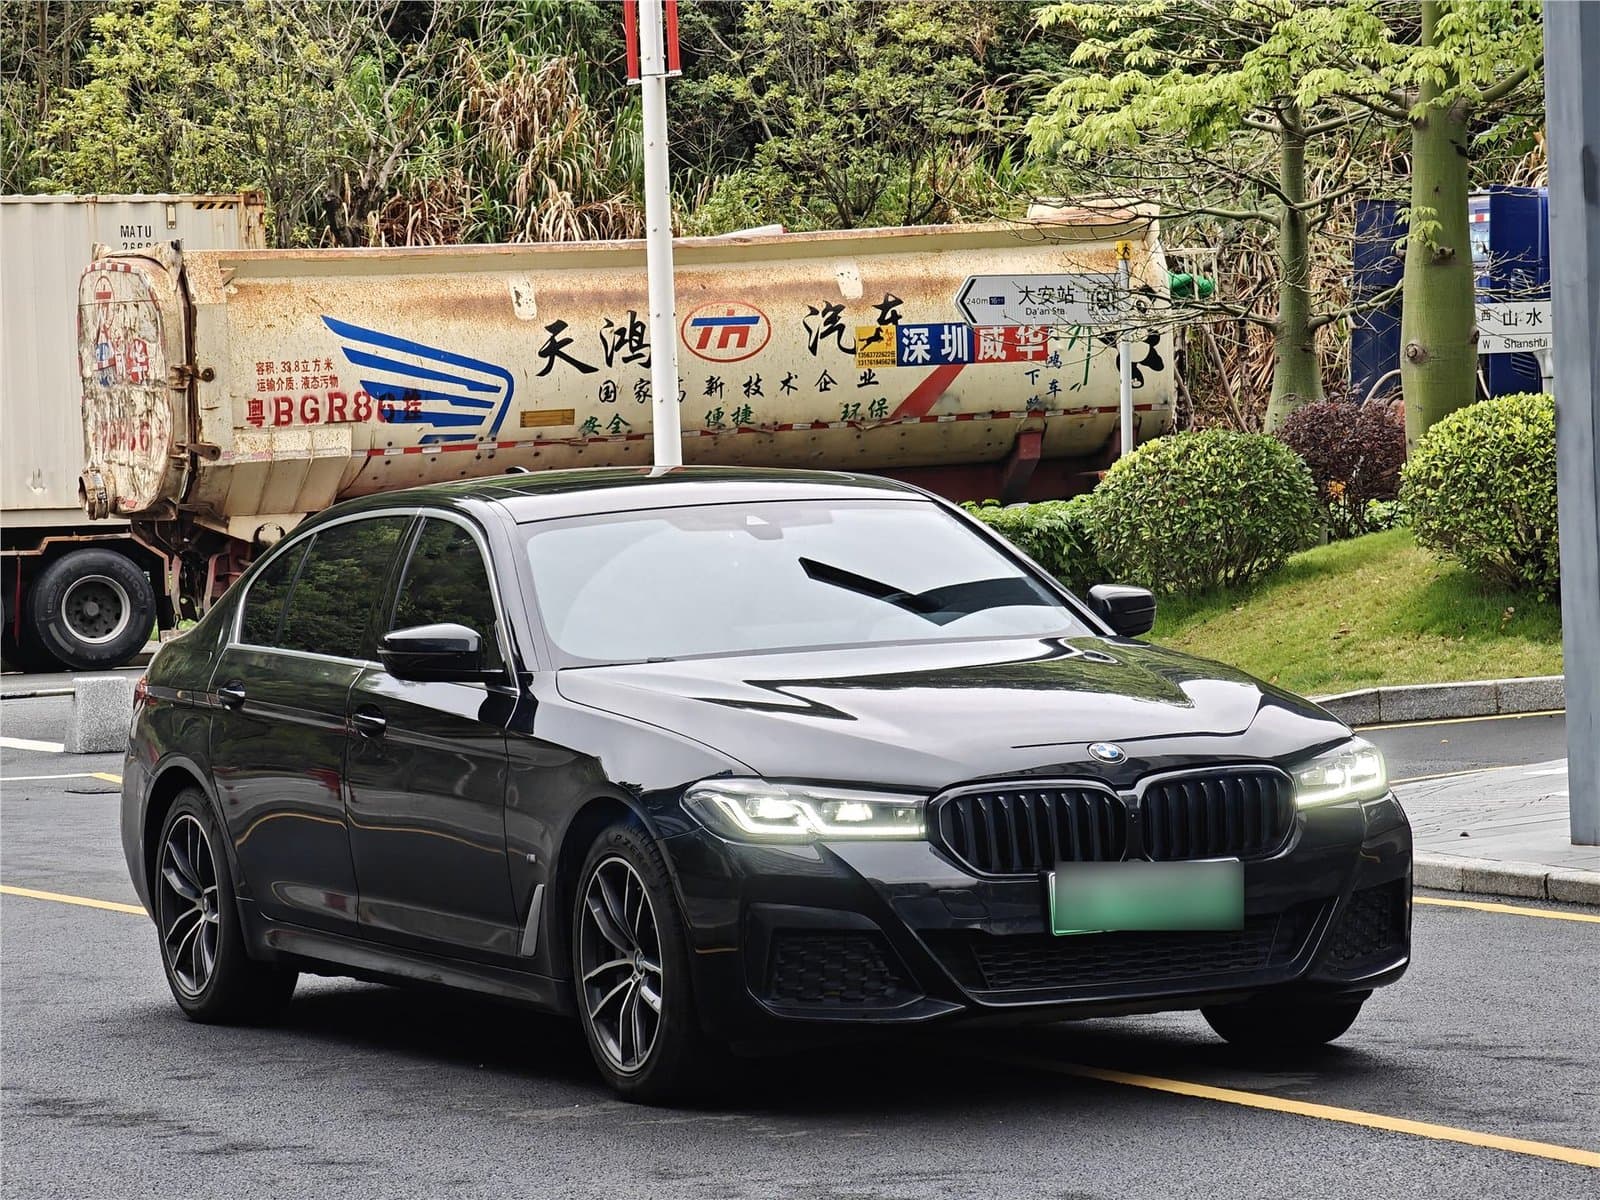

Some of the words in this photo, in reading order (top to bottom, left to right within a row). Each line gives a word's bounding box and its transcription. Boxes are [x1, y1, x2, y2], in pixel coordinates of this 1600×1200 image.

[120, 225, 152, 238] MATU
[966, 297, 989, 305] 240m
[1018, 285, 1075, 305] 大安站
[1025, 307, 1050, 316] Da'an
[1481, 309, 1491, 321] 西
[1503, 307, 1543, 326] 山水
[1482, 340, 1491, 349] W
[578, 413, 630, 436] 安全
[704, 406, 755, 427] 便捷
[841, 399, 889, 420] 环保
